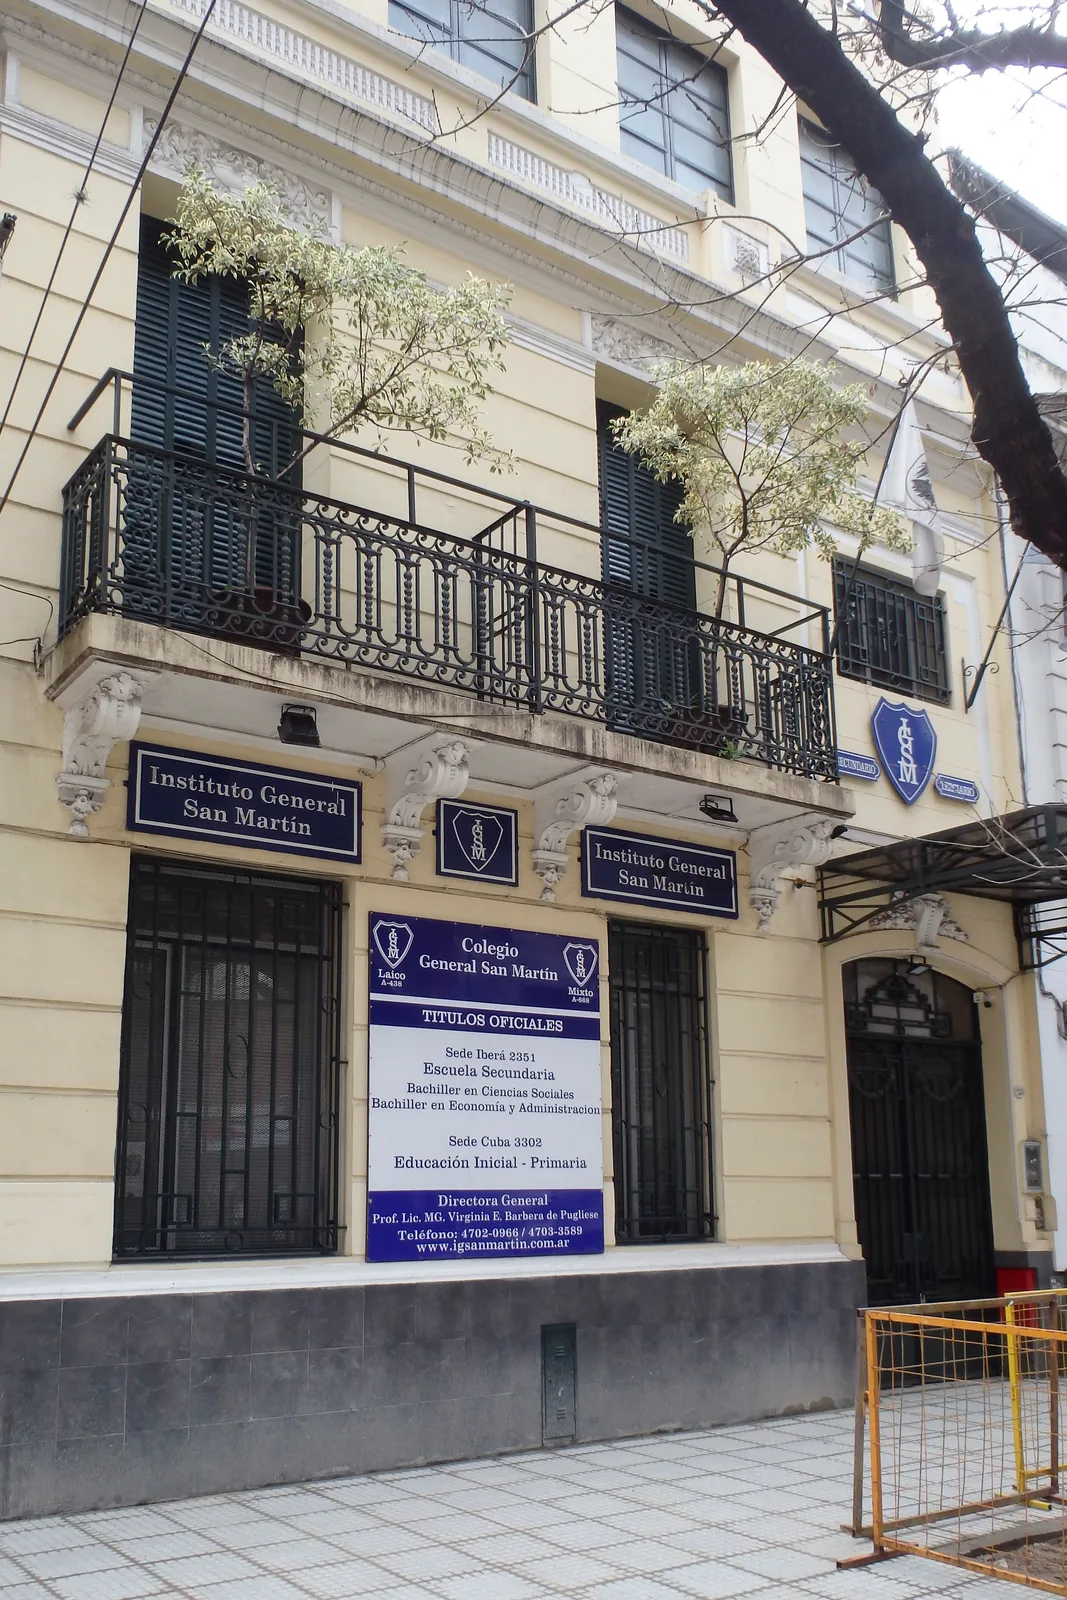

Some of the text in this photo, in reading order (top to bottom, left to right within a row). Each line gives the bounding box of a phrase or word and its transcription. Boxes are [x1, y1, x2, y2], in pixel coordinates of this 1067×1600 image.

[150, 765, 346, 816] Instituto General
[184, 798, 312, 836] San Martín
[595, 842, 726, 880] Instituto General
[618, 869, 704, 898] San Martín
[462, 937, 518, 960] Colegio
[378, 968, 406, 980] Laico
[420, 954, 558, 981] General San Martín
[381, 979, 402, 988] A-438
[568, 986, 594, 997] Mixto
[422, 1010, 564, 1032] TITULOS OFICIALES
[445, 1047, 536, 1062] Sede Iberá 2351
[423, 1062, 556, 1081] Escuela Secundaria
[406, 1082, 574, 1100] Bachiller en Ciencias Sociales
[372, 1098, 600, 1115] Bachiller en Economía y Administracion
[449, 1136, 542, 1148] Sede Cuba 3302
[394, 1154, 470, 1169] Educación
[474, 1156, 518, 1169] Inicial
[530, 1157, 587, 1169] Primaria
[438, 1194, 548, 1207] Directora General
[372, 1210, 599, 1224] Prof. Lic. MG. Virginia E. Barbera de Pugliese
[398, 1230, 458, 1240] Teléfono:
[461, 1227, 518, 1239] 4702-0966
[528, 1226, 582, 1237] 4703-3589
[416, 1238, 570, 1253] www.igsanmartin.com.ar
